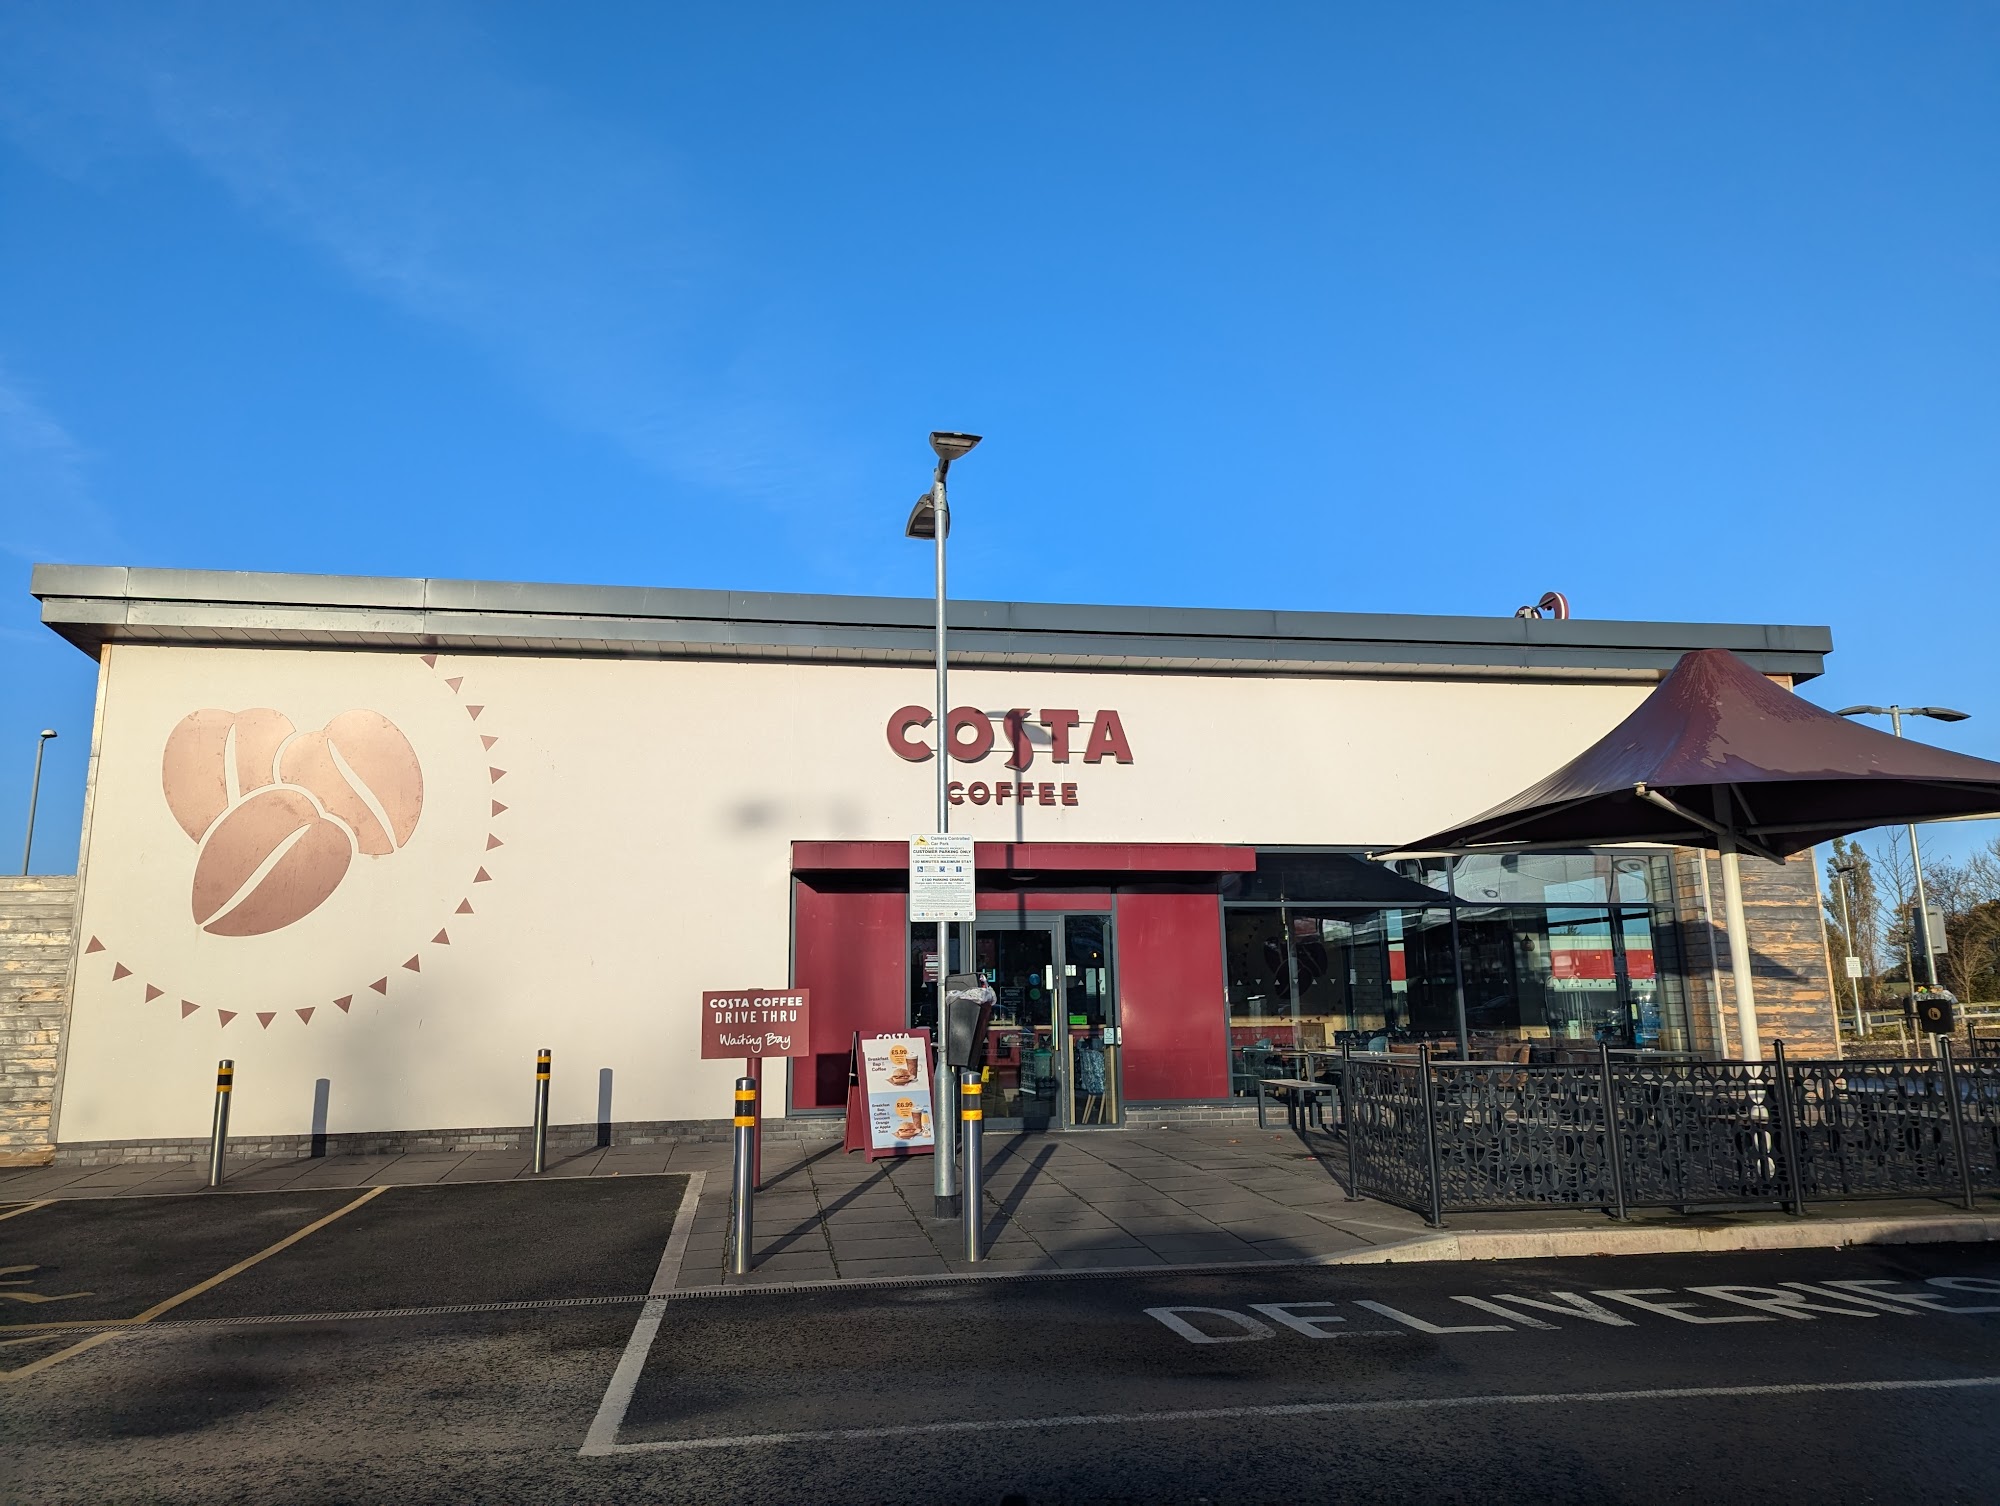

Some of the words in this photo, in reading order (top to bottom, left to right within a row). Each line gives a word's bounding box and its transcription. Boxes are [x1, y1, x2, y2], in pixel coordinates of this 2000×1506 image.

[887, 705, 1134, 772] COSTA
[947, 781, 1078, 806] COFFEE
[709, 998, 750, 1009] COSTA
[754, 996, 803, 1007] COFFEE
[715, 1011, 757, 1024] DRIVE
[762, 1010, 797, 1023] THRU
[720, 1032, 762, 1054] Waiting
[764, 1032, 791, 1050] Bay
